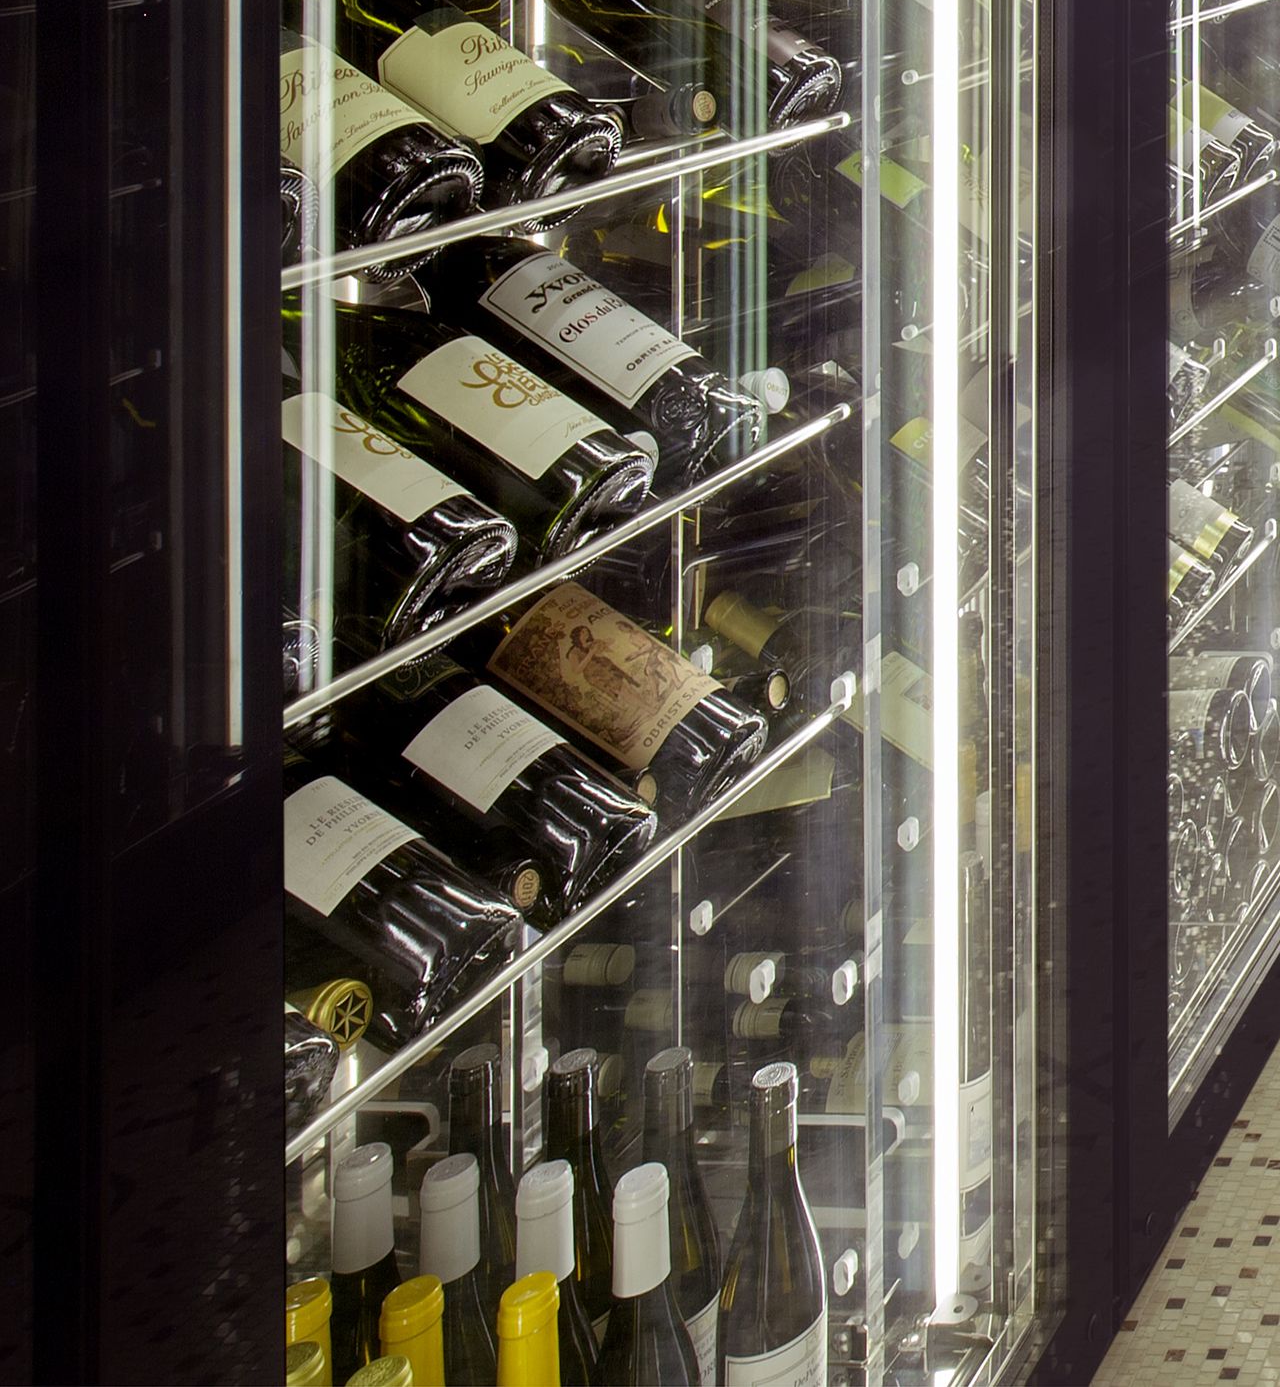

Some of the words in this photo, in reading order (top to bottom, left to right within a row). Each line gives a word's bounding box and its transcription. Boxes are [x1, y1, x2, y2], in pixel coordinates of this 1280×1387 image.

[558, 311, 599, 344] Clos
[626, 343, 663, 372] OBRIST
[463, 735, 481, 750] DE
[479, 709, 519, 735] PHILIPP
[466, 722, 482, 736] LE
[496, 717, 531, 740] YVORN
[642, 700, 682, 749] OBRIST
[305, 829, 325, 847] DE
[324, 801, 369, 830] PHILIPP
[309, 815, 327, 831] LE
[343, 810, 380, 835] YVORN
